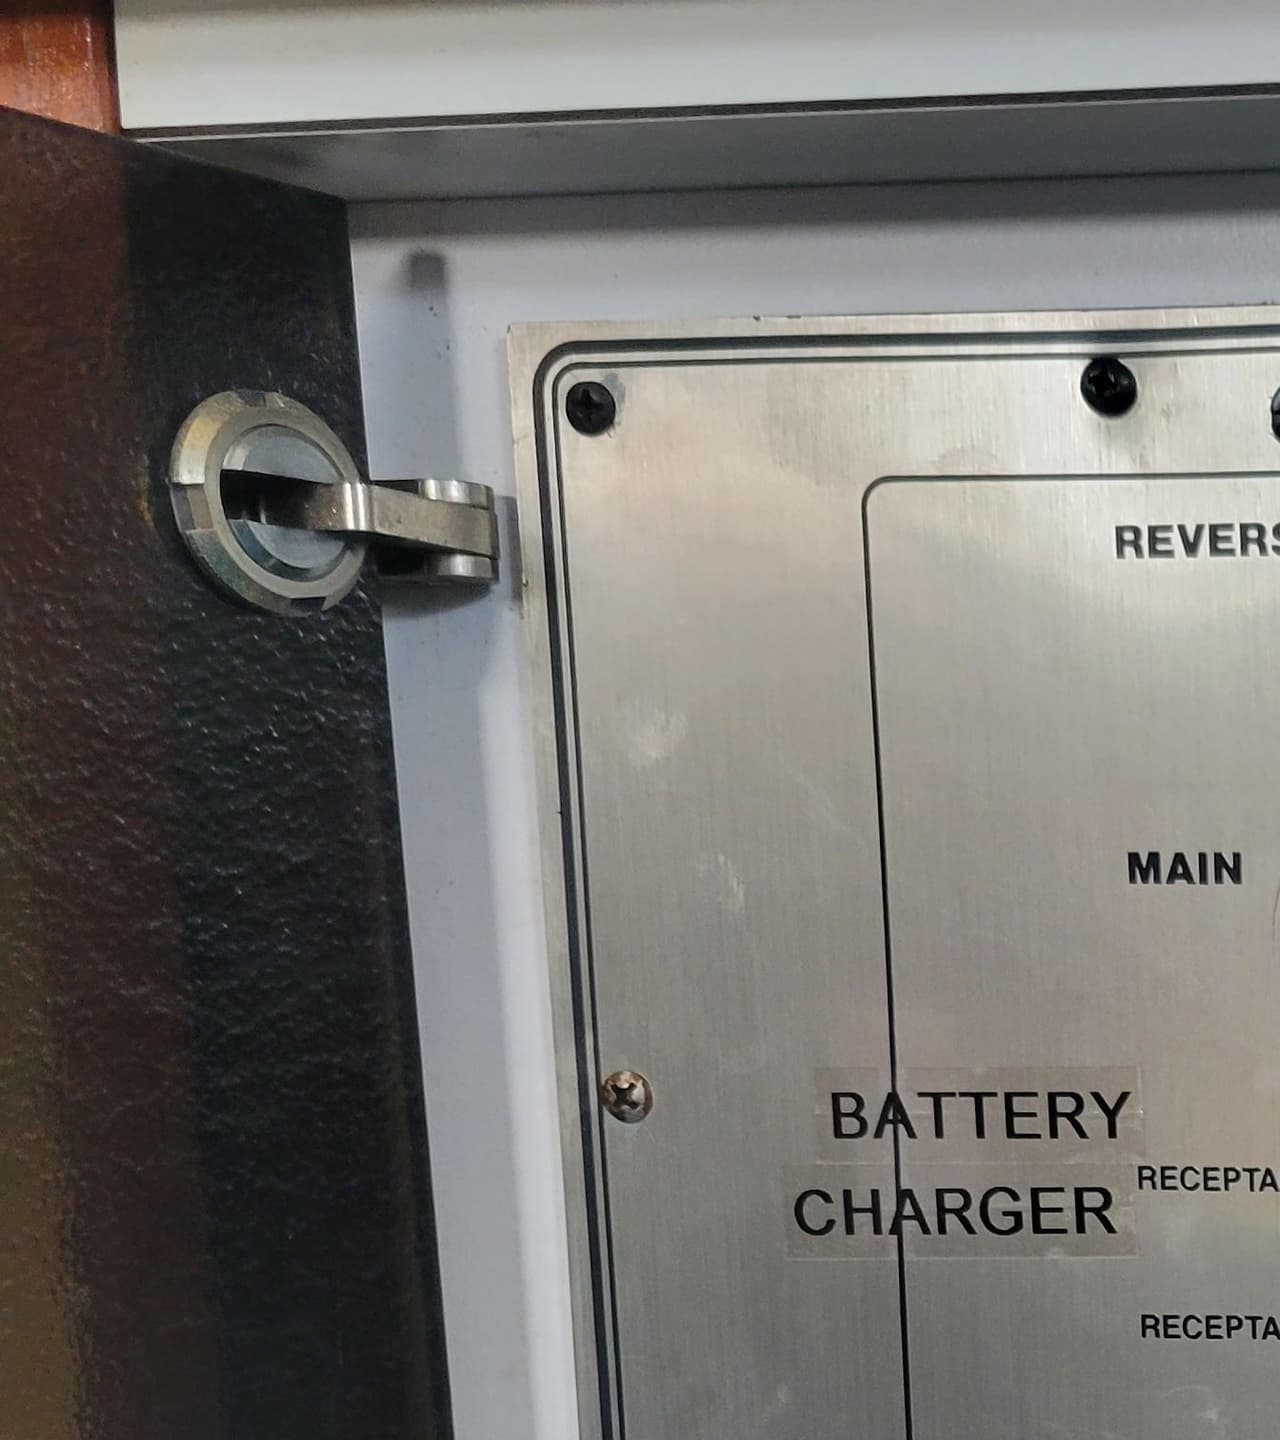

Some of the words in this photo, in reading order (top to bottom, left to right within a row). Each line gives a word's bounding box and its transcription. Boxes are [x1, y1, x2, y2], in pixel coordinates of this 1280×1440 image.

[1127, 851, 1242, 885] MAIN
[831, 1091, 1132, 1140] BATTERY
[793, 1186, 1119, 1237] CHARGER
